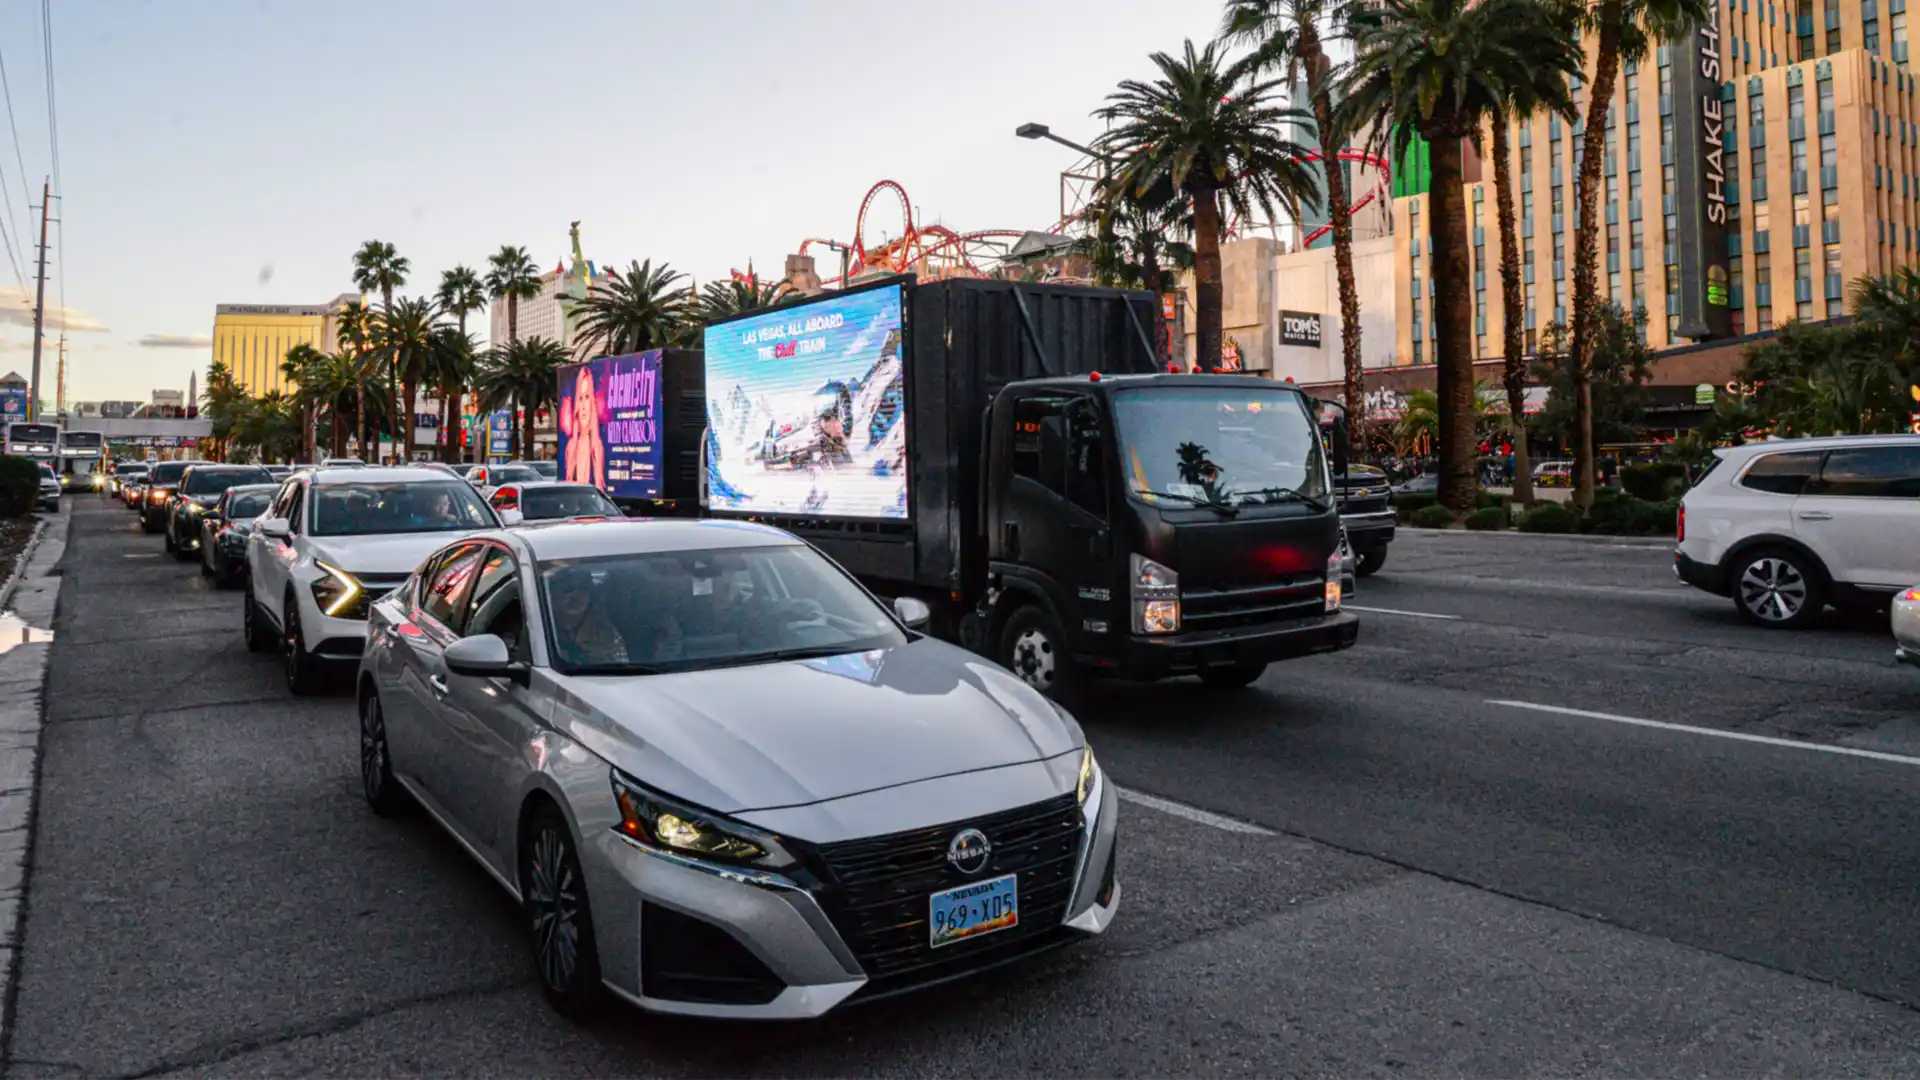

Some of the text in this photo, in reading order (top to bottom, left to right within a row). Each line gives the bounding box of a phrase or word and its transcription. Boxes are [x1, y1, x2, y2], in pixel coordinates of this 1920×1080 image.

[1704, 96, 1726, 224] SHAKE
[742, 330, 757, 345] LAS
[787, 321, 803, 336] ALL
[805, 312, 845, 333] ABOARD
[1283, 316, 1321, 335] TOM'S
[757, 345, 774, 361] THE
[799, 336, 826, 354] TRAIN
[608, 357, 656, 418] chemistry
[947, 844, 992, 861] NISSAN
[952, 882, 995, 900] NEVADA
